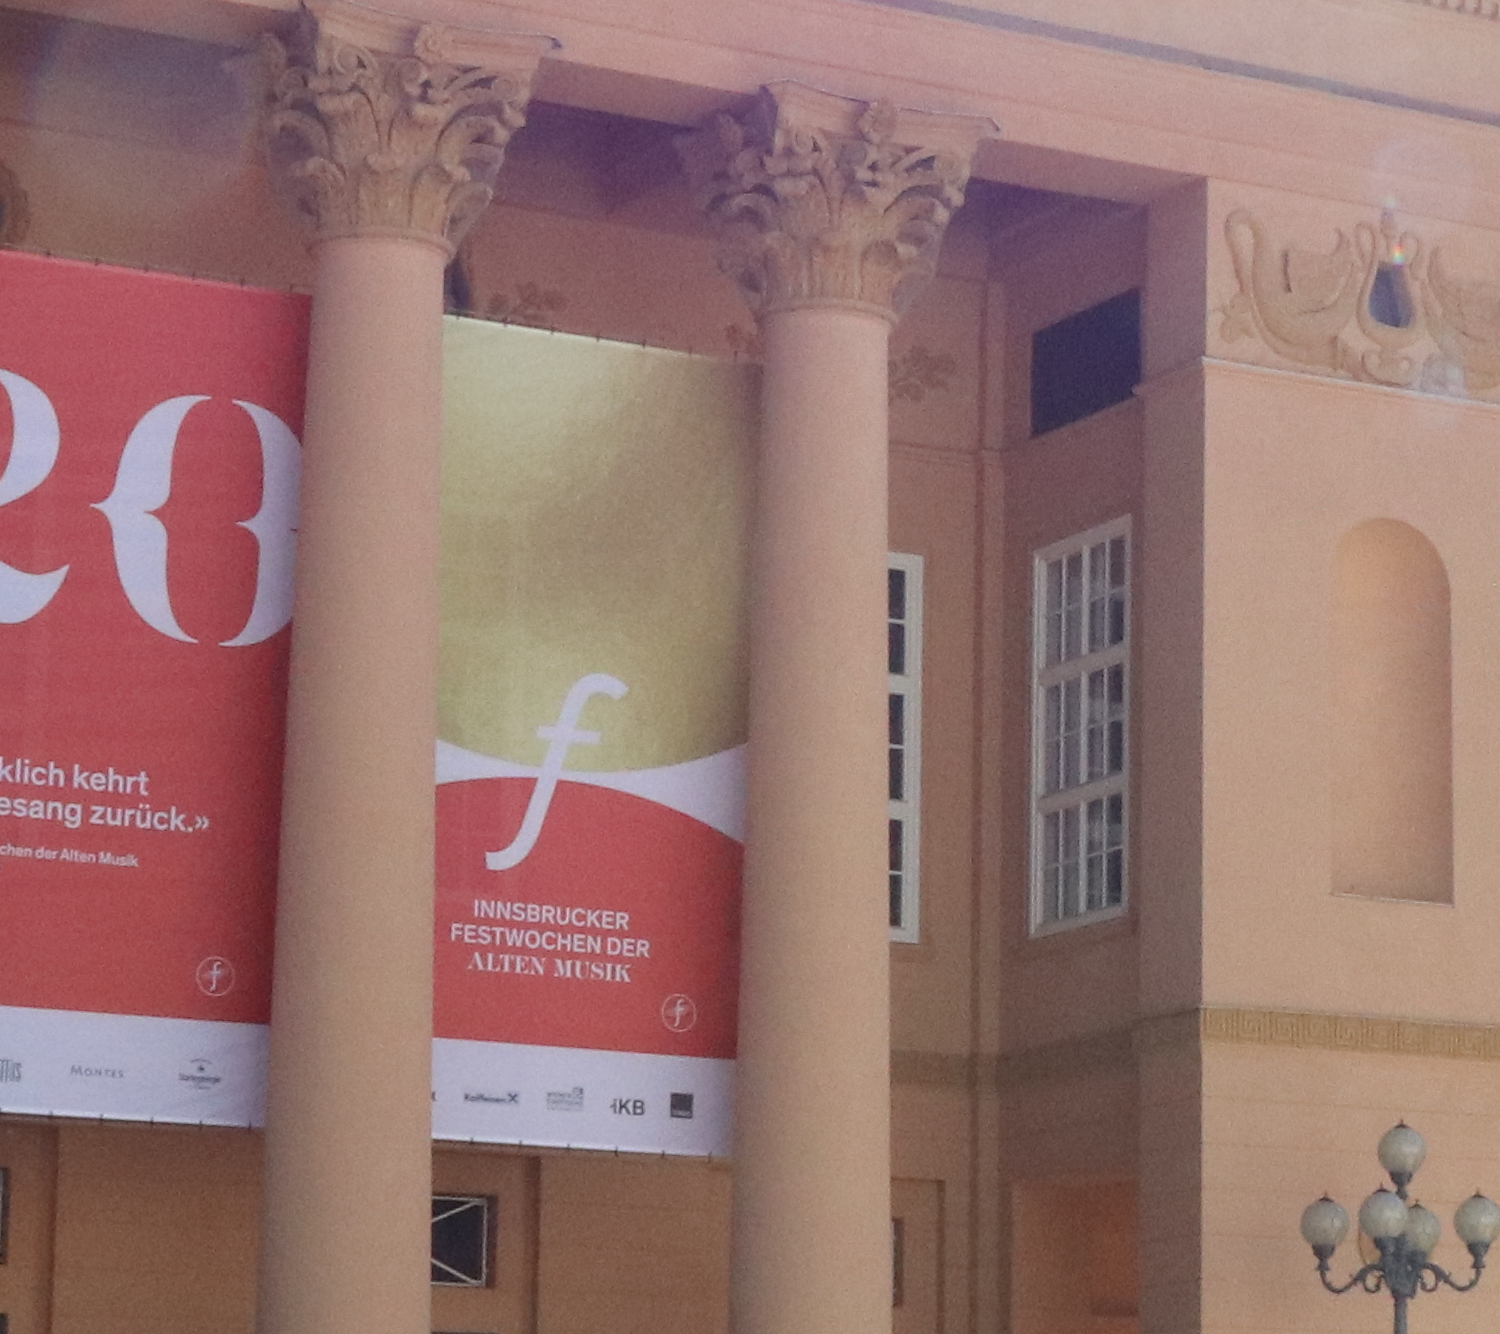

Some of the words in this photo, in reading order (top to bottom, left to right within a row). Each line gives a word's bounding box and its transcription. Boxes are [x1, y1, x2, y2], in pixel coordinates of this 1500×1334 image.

[72, 763, 150, 796] kehrt
[89, 803, 210, 832] zurück.»
[35, 846, 58, 861] der
[60, 848, 96, 864] Alten
[98, 850, 139, 867] Musik
[472, 898, 630, 931] INNSBRUCKER
[450, 922, 601, 954] FESTWOCHEN
[606, 937, 650, 960] DER
[466, 953, 546, 977] ALTEN
[553, 961, 632, 984] MUSIK
